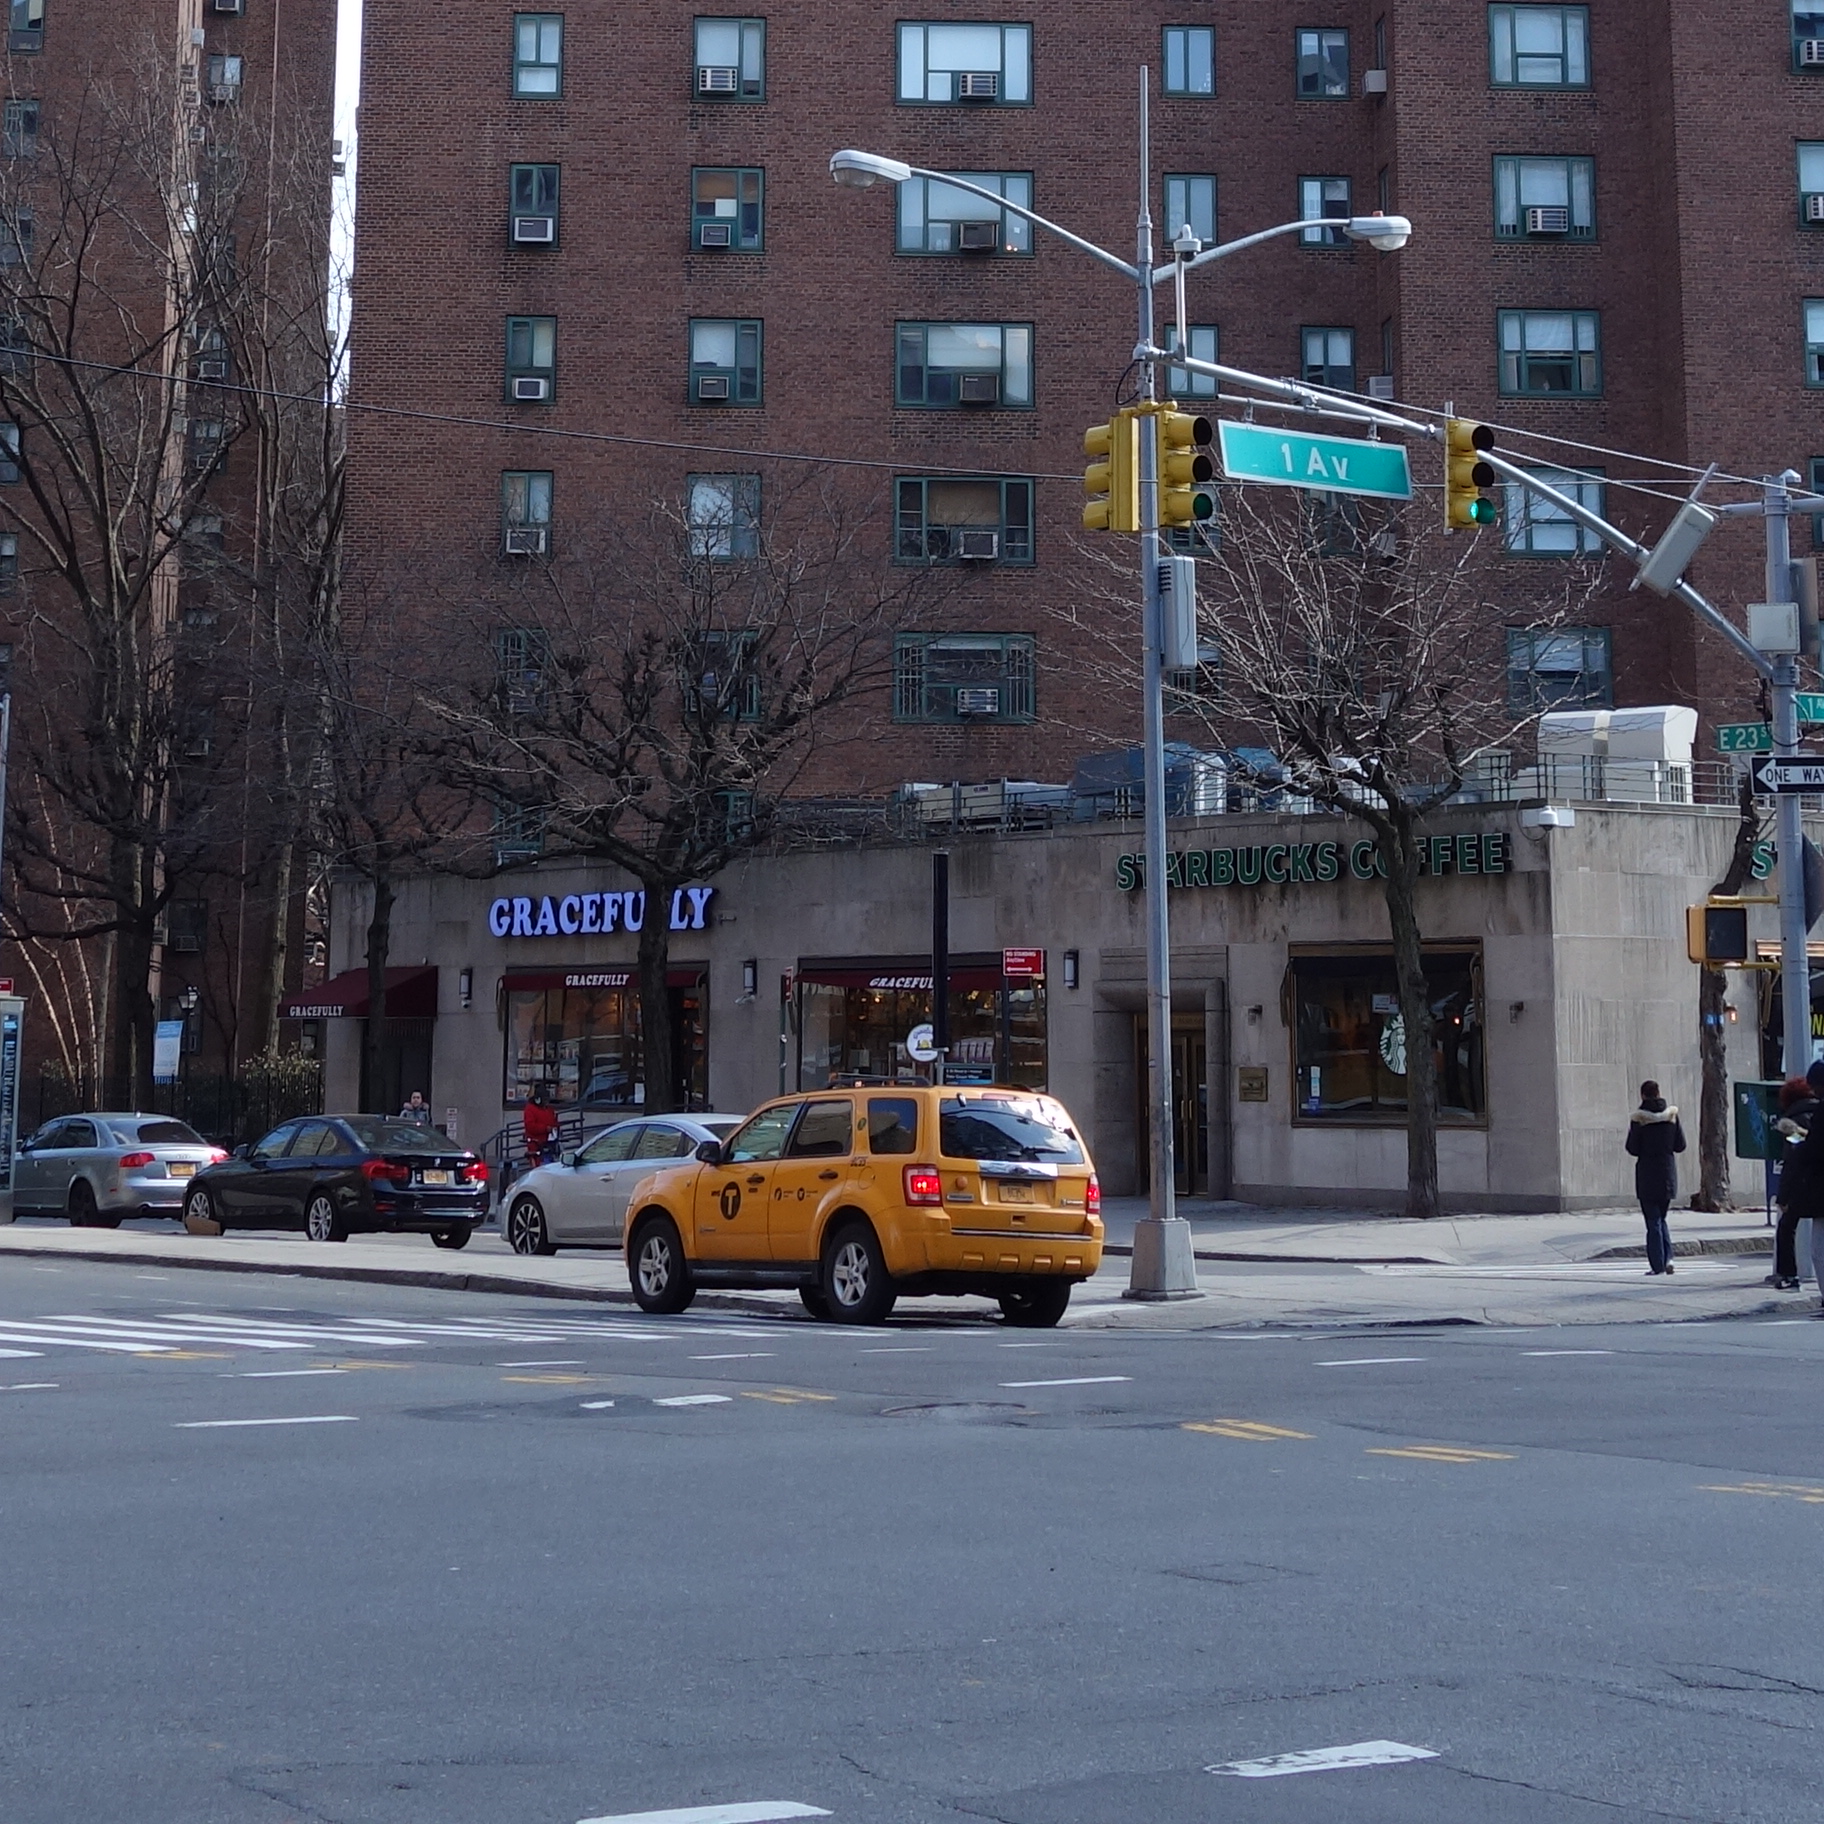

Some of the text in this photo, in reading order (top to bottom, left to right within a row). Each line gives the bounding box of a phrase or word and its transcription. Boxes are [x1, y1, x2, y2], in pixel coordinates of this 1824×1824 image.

[1281, 443, 1293, 473] 1
[1807, 697, 1814, 718] 1
[1719, 728, 1730, 750] E
[1736, 726, 1758, 749] 23
[1765, 768, 1791, 783] ONE
[1350, 832, 1506, 880] CFEE
[489, 887, 713, 937] GRACEFULY
[565, 974, 630, 987] GRACEFULLY
[289, 1005, 344, 1017] GRACEFULLY
